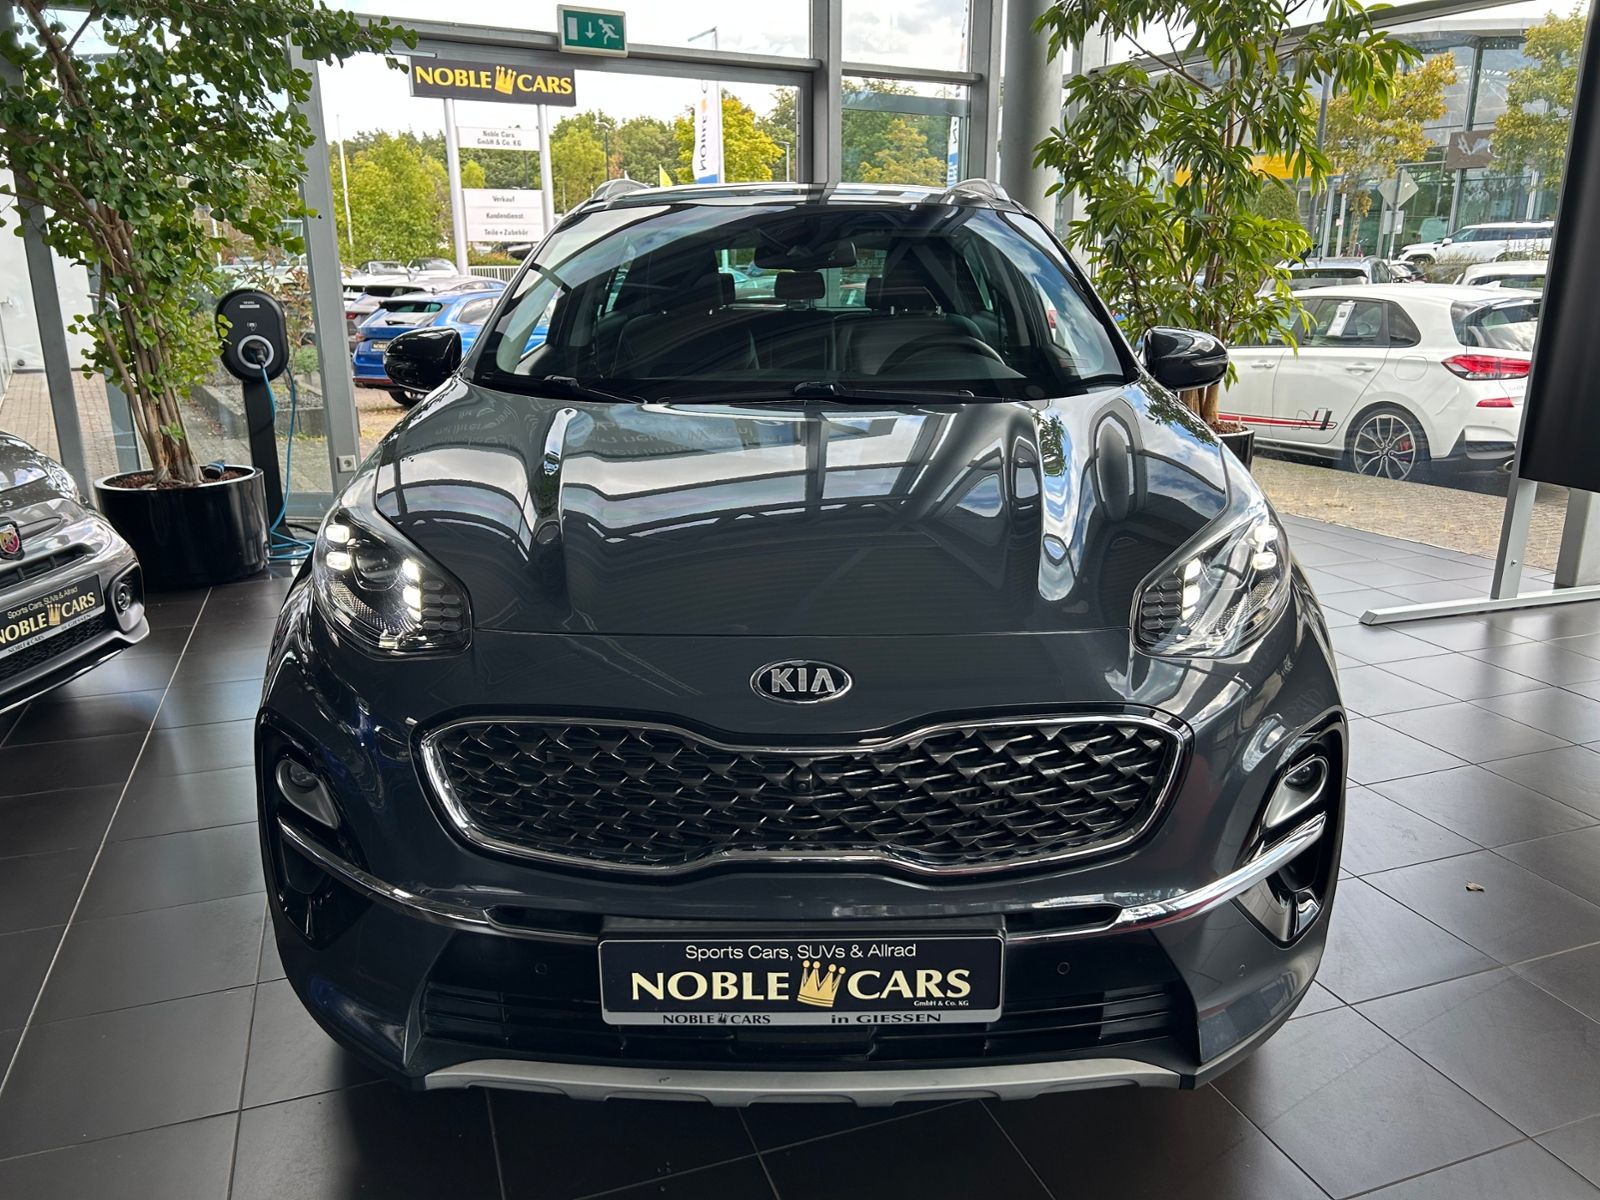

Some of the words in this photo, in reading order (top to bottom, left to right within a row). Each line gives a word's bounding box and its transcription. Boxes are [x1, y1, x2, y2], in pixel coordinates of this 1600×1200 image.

[415, 65, 492, 89] NOBLE
[516, 74, 573, 95] CARS
[482, 130, 499, 138] Noble
[500, 131, 515, 139] Cars
[491, 195, 515, 203] Verkauf
[484, 228, 498, 236] Teile
[503, 228, 529, 236] Zubehör
[7, 606, 28, 619] Sports
[43, 594, 59, 604] SUVs
[58, 591, 64, 599] &
[64, 586, 78, 596] Allrad
[61, 591, 96, 617] CARS
[770, 667, 836, 693] KIA
[685, 944, 744, 962] Sports
[747, 944, 793, 961] Cars,
[797, 944, 846, 959] SUVs
[850, 944, 864, 958] &
[867, 943, 917, 958] Allrad
[631, 971, 790, 1001] NOBLE
[847, 968, 971, 1000] CARS
[662, 1014, 715, 1024] NOBLE
[730, 1013, 771, 1024] CARS
[831, 1014, 849, 1024] in
[856, 1013, 941, 1024] GIESSEN
